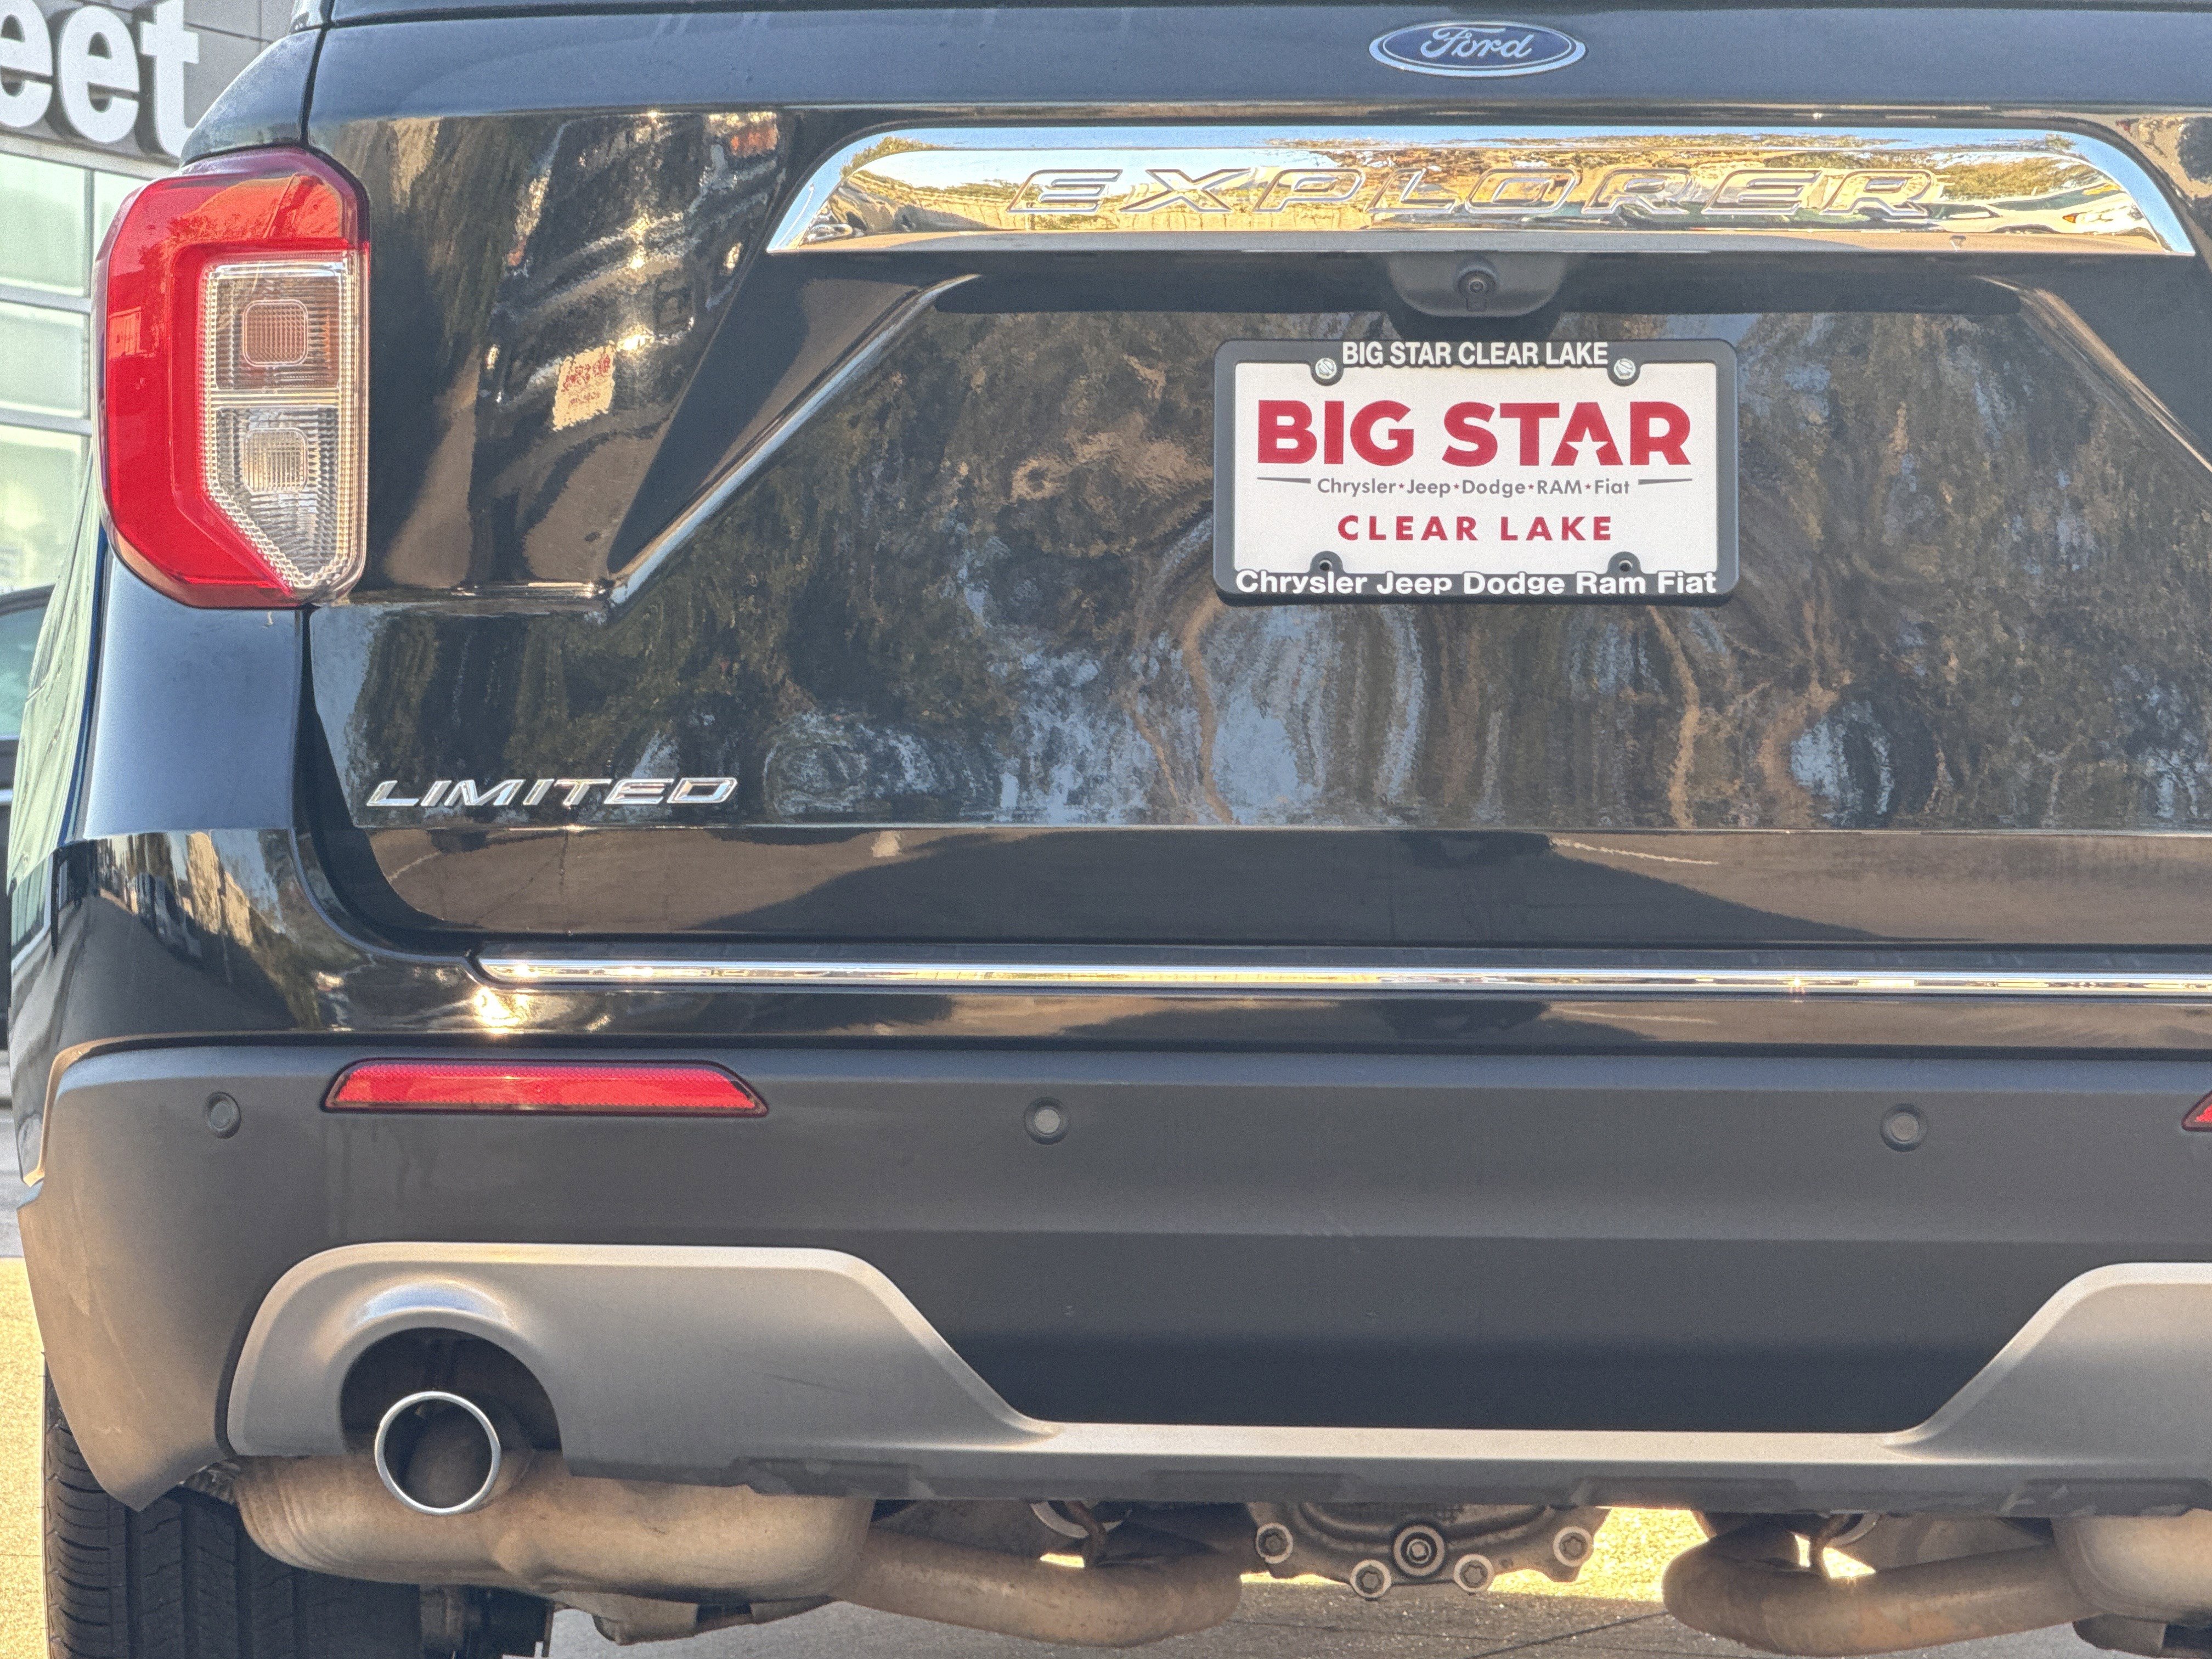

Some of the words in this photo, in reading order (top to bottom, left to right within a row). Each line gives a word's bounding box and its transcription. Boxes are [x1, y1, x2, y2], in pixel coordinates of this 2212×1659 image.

[1420, 26, 1534, 59] Ford
[1006, 167, 1939, 217] EXPLORER
[1342, 341, 1383, 364] BIG
[1390, 341, 1452, 364] STAR
[1458, 341, 1538, 365] CLEAR
[1546, 341, 1608, 365] LAKE
[1257, 399, 1414, 466] BIG
[1442, 401, 1691, 466] STAR
[1317, 477, 1396, 498] Chrysler
[1406, 478, 1451, 498] Jeep
[1462, 478, 1525, 498] Dodge
[1537, 479, 1582, 495] RAM
[1594, 478, 1630, 495] Fiat
[1338, 515, 1478, 541] CLEAR
[1500, 516, 1611, 541] LAKE
[1235, 569, 1368, 594] Chrysler
[1377, 571, 1453, 596] Jeep
[1464, 572, 1565, 596] Dodge
[1576, 572, 1645, 595] Ram
[1657, 571, 1718, 595] Fiat
[366, 777, 738, 806] LIMITED
